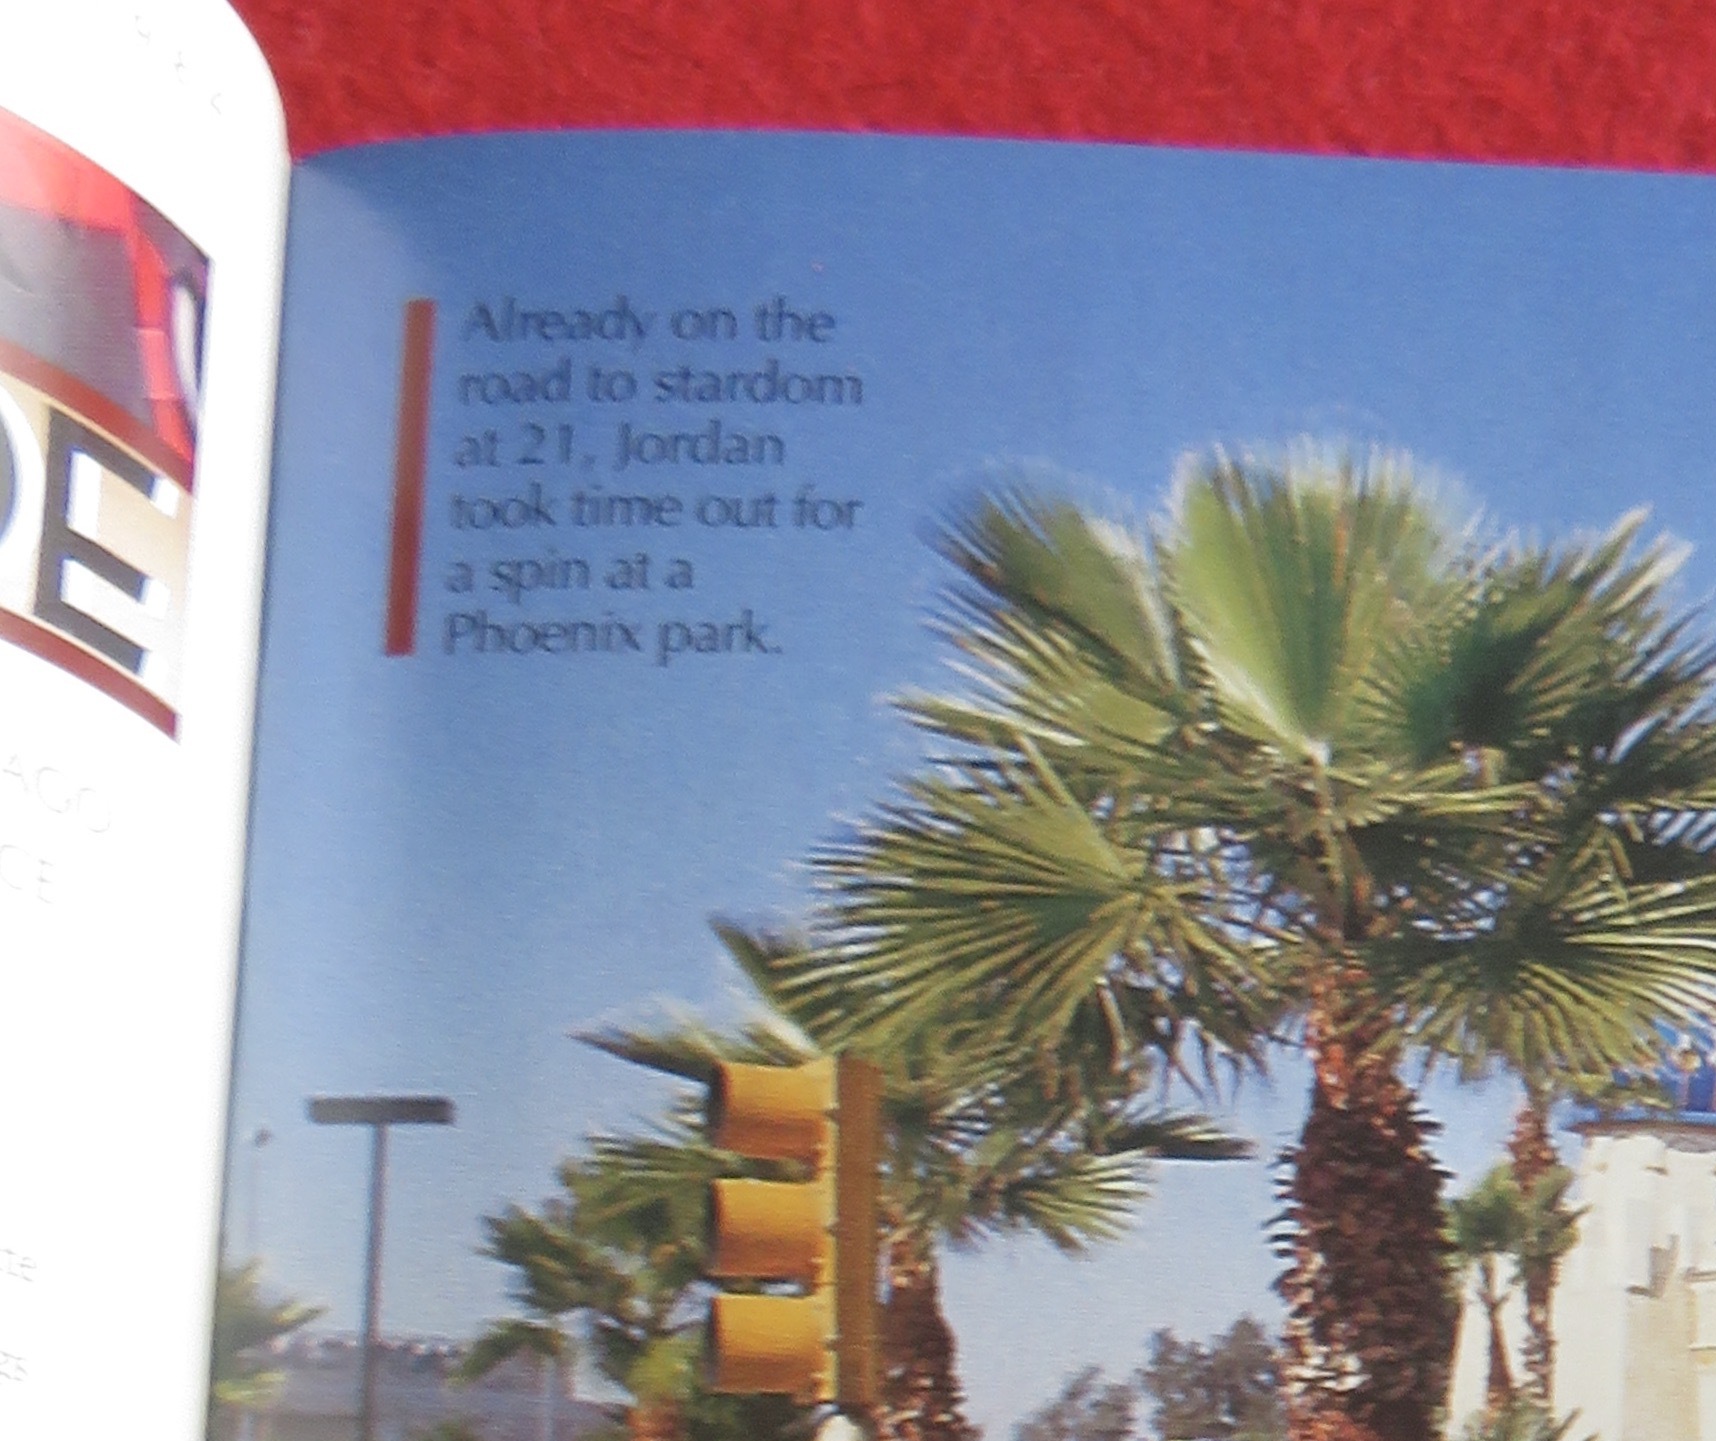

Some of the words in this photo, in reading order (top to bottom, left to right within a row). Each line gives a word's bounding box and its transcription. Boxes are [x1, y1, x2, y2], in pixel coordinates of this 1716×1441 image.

[461, 295, 650, 350] Already
[671, 305, 738, 342] on
[754, 295, 836, 342] the
[457, 358, 572, 404] road
[587, 365, 637, 403] to
[654, 358, 865, 404] stardom
[454, 428, 500, 467] at
[613, 419, 786, 470] Jordan
[450, 482, 556, 530] took
[570, 484, 684, 528] time
[695, 492, 781, 529] out
[793, 481, 864, 530] for
[445, 561, 474, 593] a
[491, 550, 591, 605] spin
[606, 552, 651, 590] at
[664, 557, 696, 589] a
[442, 610, 643, 655] Phoenix
[656, 609, 782, 666] park.
